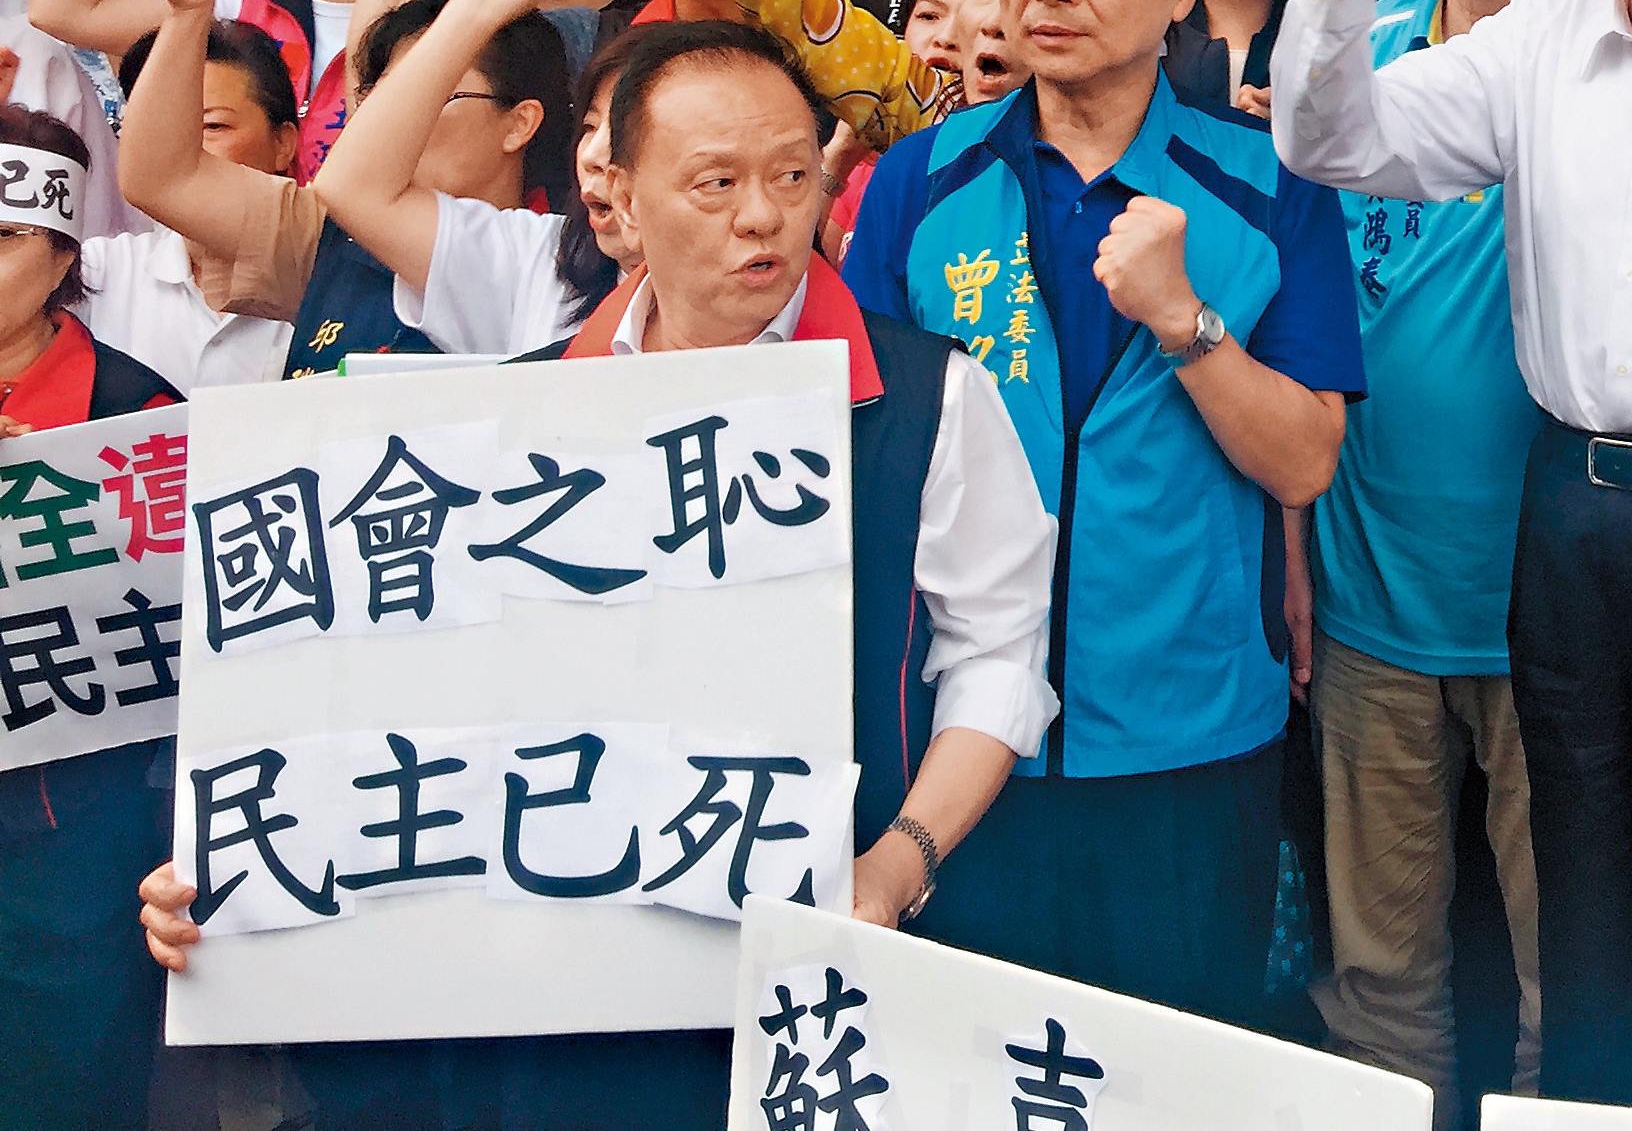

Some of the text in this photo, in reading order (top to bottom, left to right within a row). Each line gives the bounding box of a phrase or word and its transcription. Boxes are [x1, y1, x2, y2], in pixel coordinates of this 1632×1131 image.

[0, 160, 74, 220] 已死
[1003, 231, 1039, 384] 立法委員
[0, 434, 188, 589] 全違
[192, 414, 833, 653] 國會之恥
[0, 588, 182, 732] 民主
[190, 732, 816, 926] 民主已死
